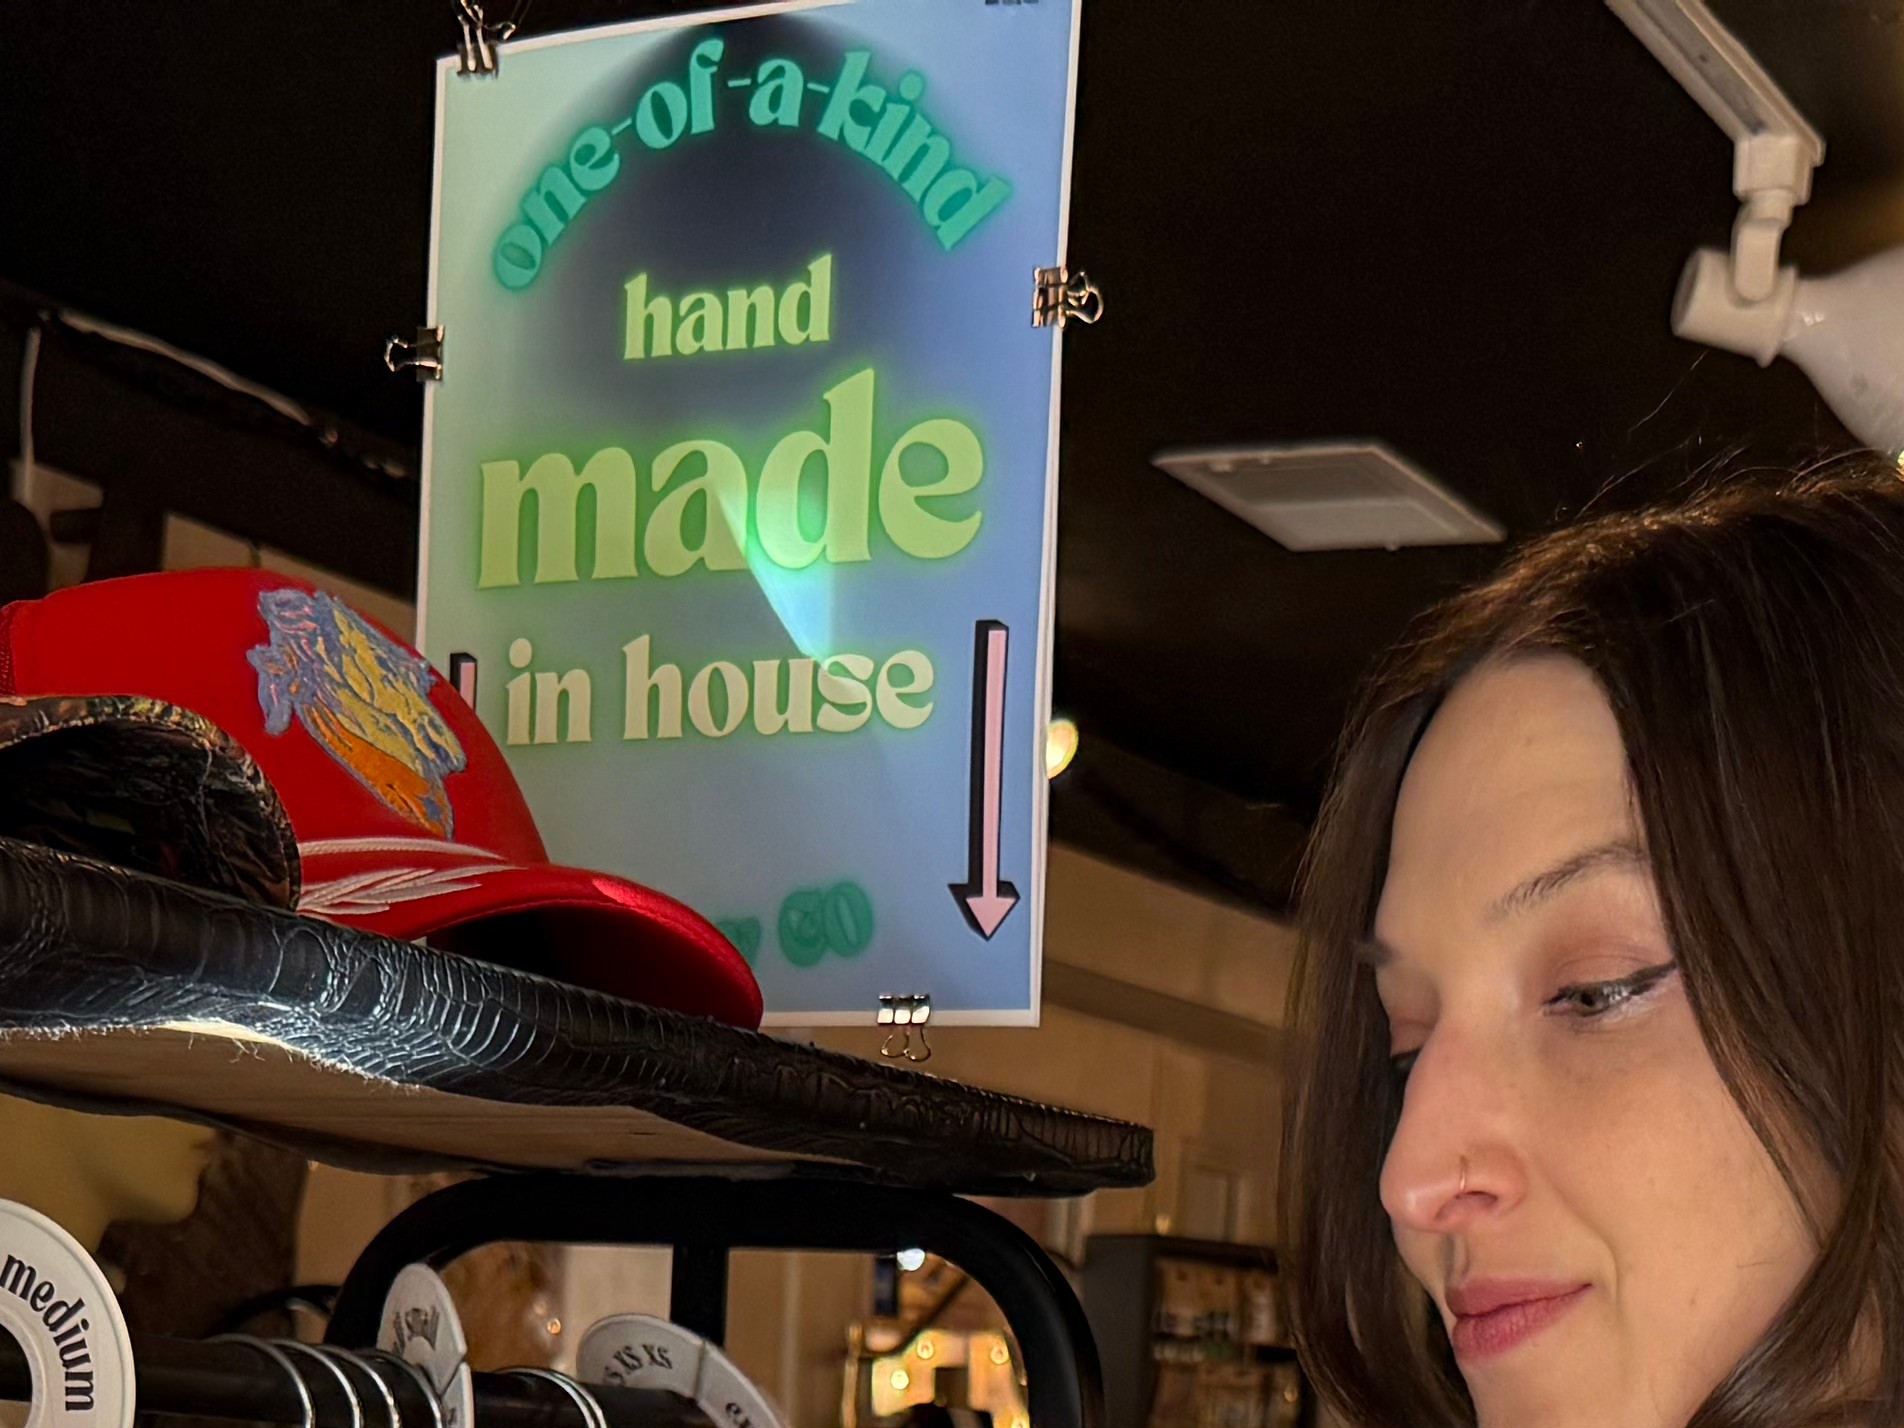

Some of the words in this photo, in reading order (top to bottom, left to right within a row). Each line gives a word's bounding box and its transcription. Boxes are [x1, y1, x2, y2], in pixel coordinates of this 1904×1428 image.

[496, 37, 1010, 290] one-of-a-kind
[625, 255, 833, 361] hand
[477, 368, 984, 589] made
[507, 637, 592, 745] in
[623, 633, 935, 741] house
